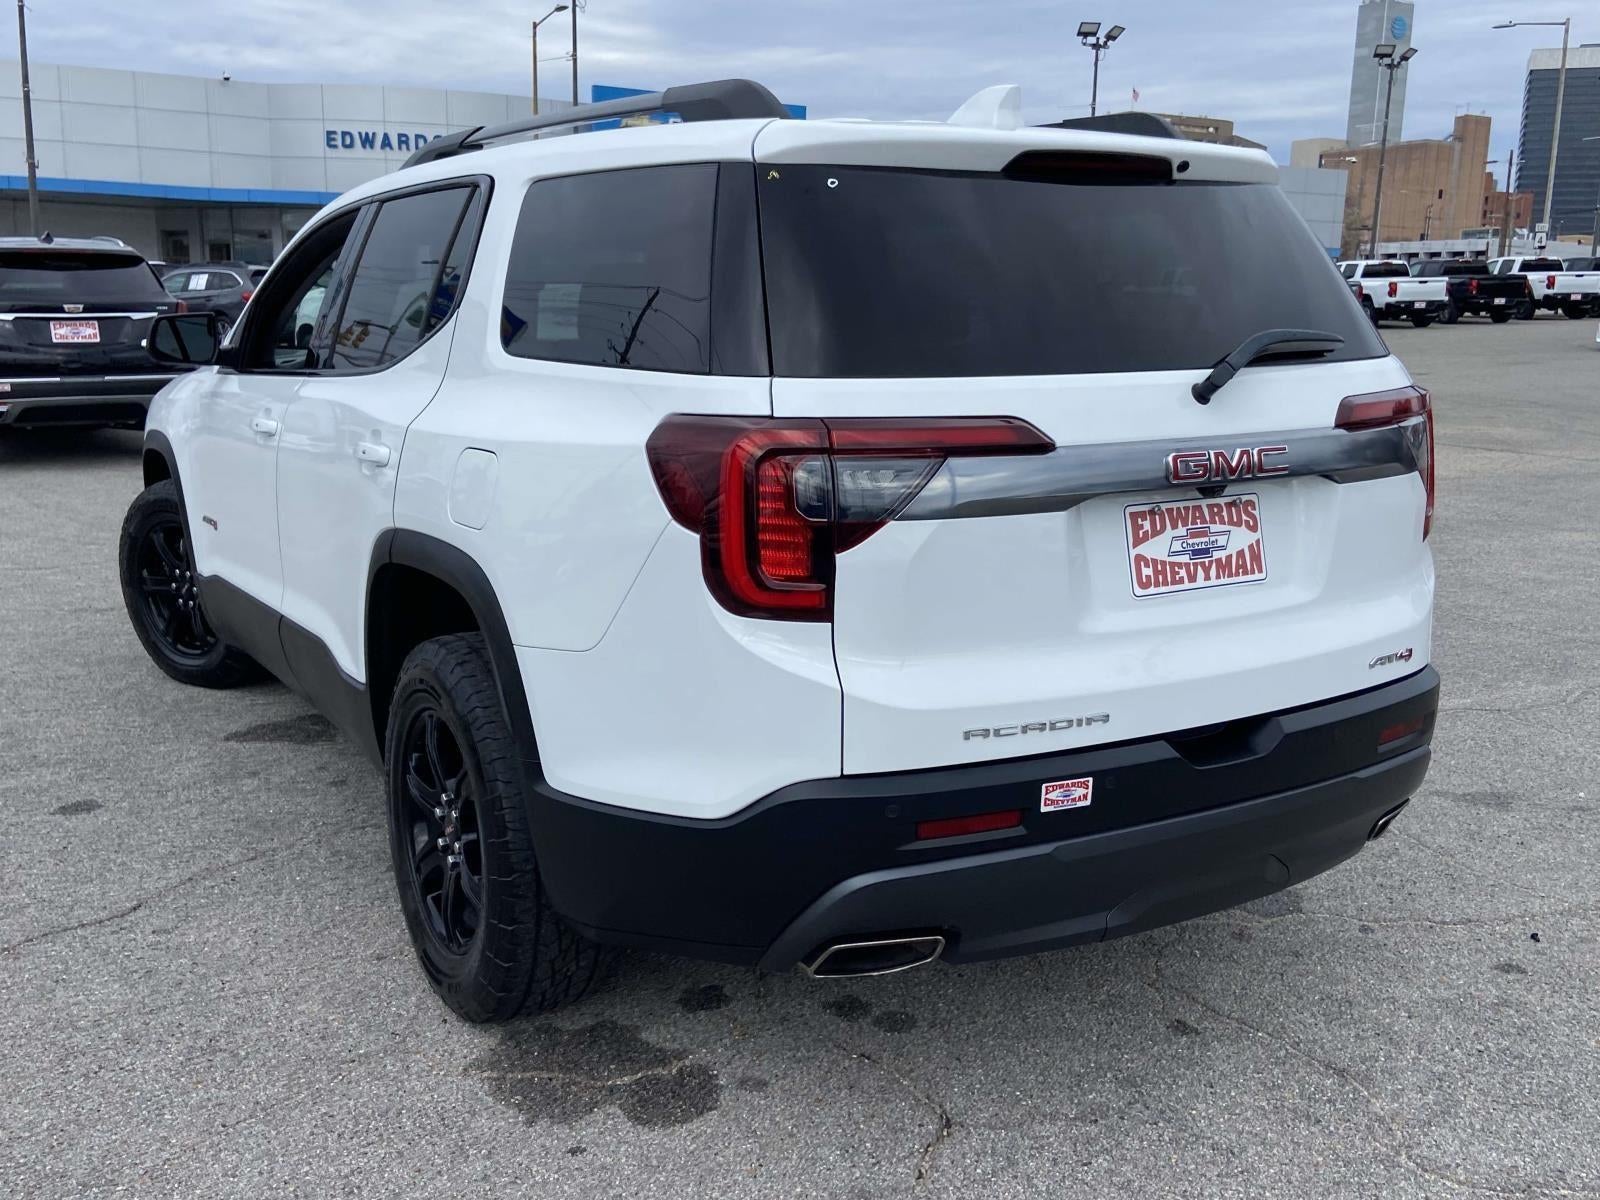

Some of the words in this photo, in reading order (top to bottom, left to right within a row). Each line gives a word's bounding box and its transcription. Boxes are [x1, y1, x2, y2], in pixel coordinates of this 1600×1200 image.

[1167, 445, 1289, 484] GMC
[1129, 499, 1259, 550] EDWARDS
[1180, 538, 1219, 550] Chevrolet
[1134, 538, 1263, 590] CHEVYMAN
[1369, 648, 1412, 670] AT4
[963, 713, 1110, 741] ACADIA
[1044, 792, 1089, 807] CHEVYMAN
[1045, 780, 1090, 796] EDWARDS
